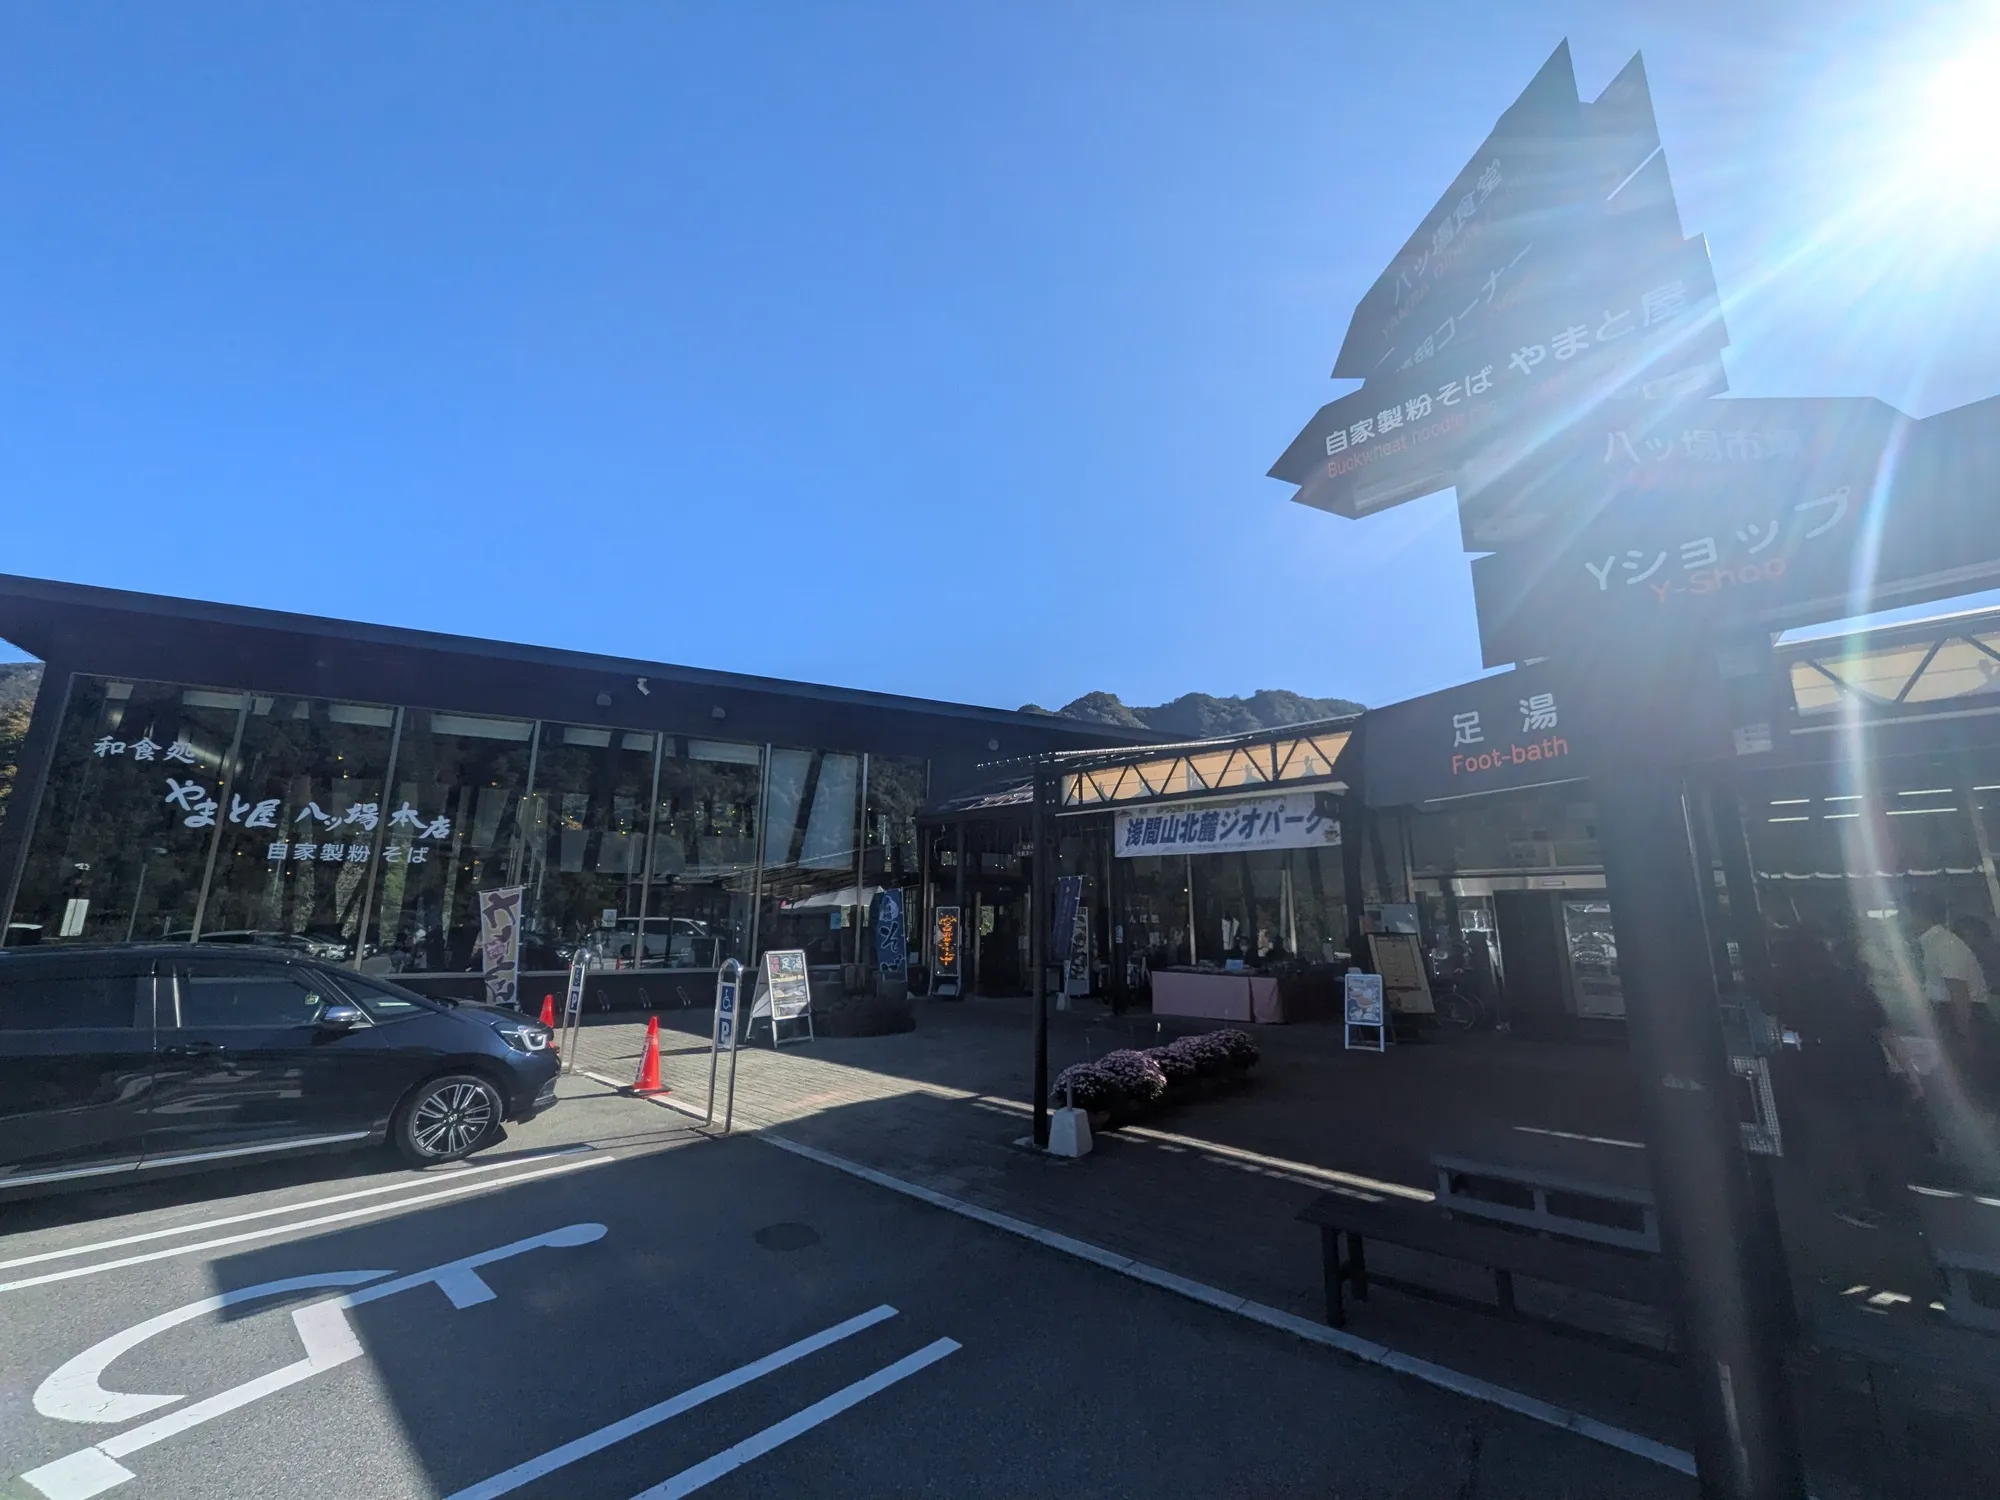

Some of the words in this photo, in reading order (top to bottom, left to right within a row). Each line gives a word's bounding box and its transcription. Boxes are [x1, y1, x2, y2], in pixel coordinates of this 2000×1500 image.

[1325, 365, 1494, 456] 自家製粉そば
[1508, 281, 1687, 375] やまと屋
[1452, 692, 1558, 748] 足湯
[94, 735, 196, 764] 和食処
[1451, 735, 1569, 776] Foot-bath
[165, 777, 281, 828] やまと屋
[294, 801, 452, 839] 八ッ場本店
[720, 1021, 730, 1043] P
